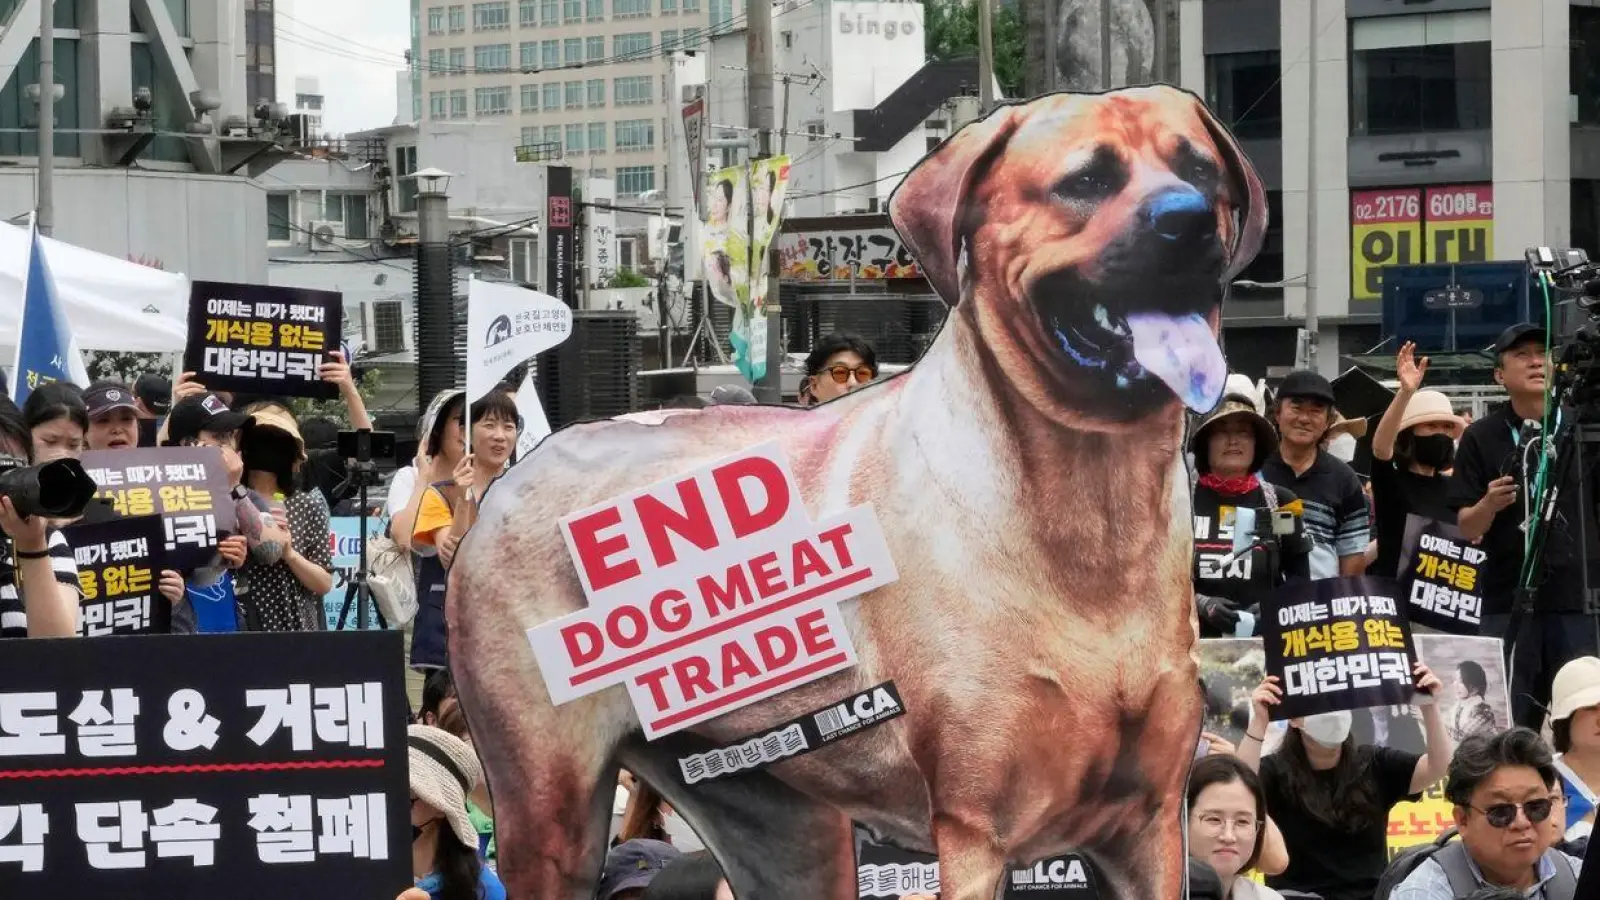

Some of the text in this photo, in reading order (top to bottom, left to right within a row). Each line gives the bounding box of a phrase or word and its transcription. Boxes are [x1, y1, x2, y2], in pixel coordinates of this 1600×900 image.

[839, 12, 916, 41] bingo
[1356, 195, 1419, 219] 02.2176
[556, 234, 564, 279] PREMIUM
[206, 299, 325, 323] 이제는 때가 됐다!
[206, 319, 325, 350] 개식용 없는
[203, 347, 323, 381] 대한민국!
[87, 464, 207, 486] 제는 때가 됐다!
[92, 485, 212, 516] 식용 없는
[568, 456, 790, 592] END
[75, 537, 149, 566] 때가 됐다!
[1420, 534, 1462, 559] 이제는
[102, 565, 152, 597] 없는
[1415, 553, 1477, 591] 개식용
[560, 523, 853, 667] DOG MEAT
[1278, 601, 1329, 626] 이제는
[1331, 596, 1367, 616] 때가
[1410, 579, 1482, 625] 대한민
[1281, 618, 1405, 657] 개식용 없는
[634, 608, 836, 711] TRADE
[1283, 652, 1413, 696] 대한민국!
[0, 682, 385, 757] 도살 & 거래
[838, 687, 898, 721] LCA
[75, 798, 221, 870] 단속
[247, 793, 389, 864] 철폐
[1034, 859, 1087, 883] LCA
